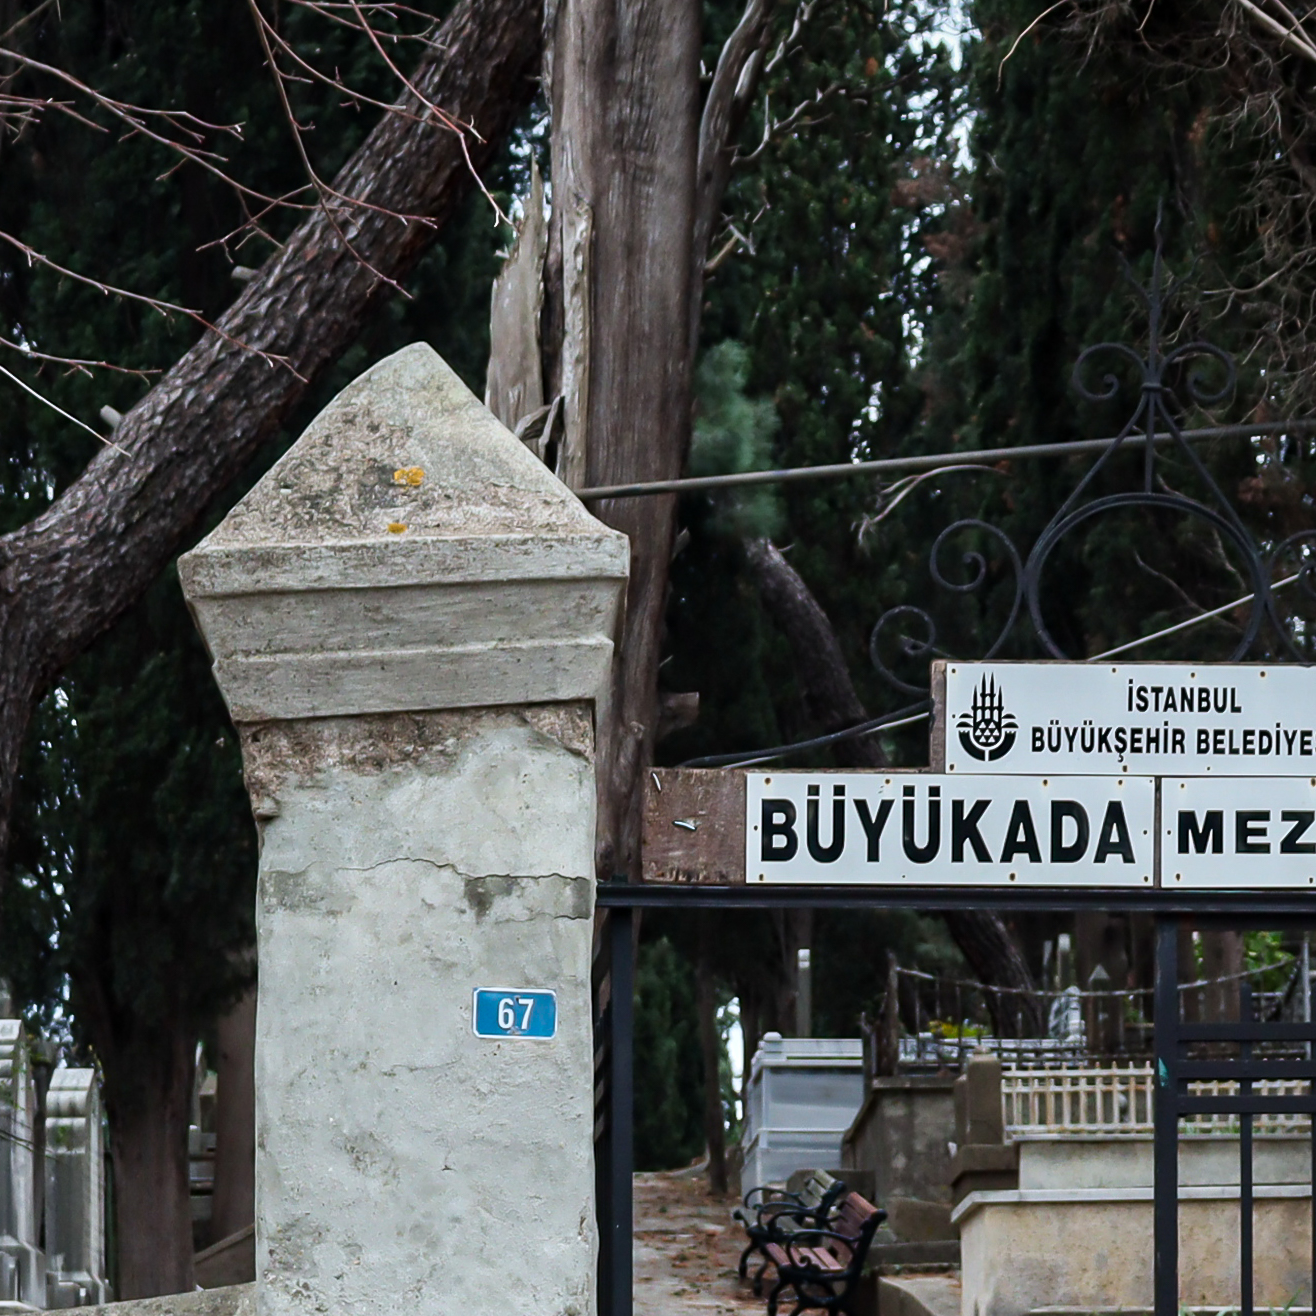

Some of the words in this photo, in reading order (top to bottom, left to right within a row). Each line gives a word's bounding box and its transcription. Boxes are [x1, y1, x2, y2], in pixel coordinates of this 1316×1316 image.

[1128, 678, 1242, 714] İSTANBUL
[1031, 719, 1186, 763] BÜYÜKŞEHİR
[760, 784, 1136, 864] BÜYÜKADA
[498, 997, 535, 1031] 67
